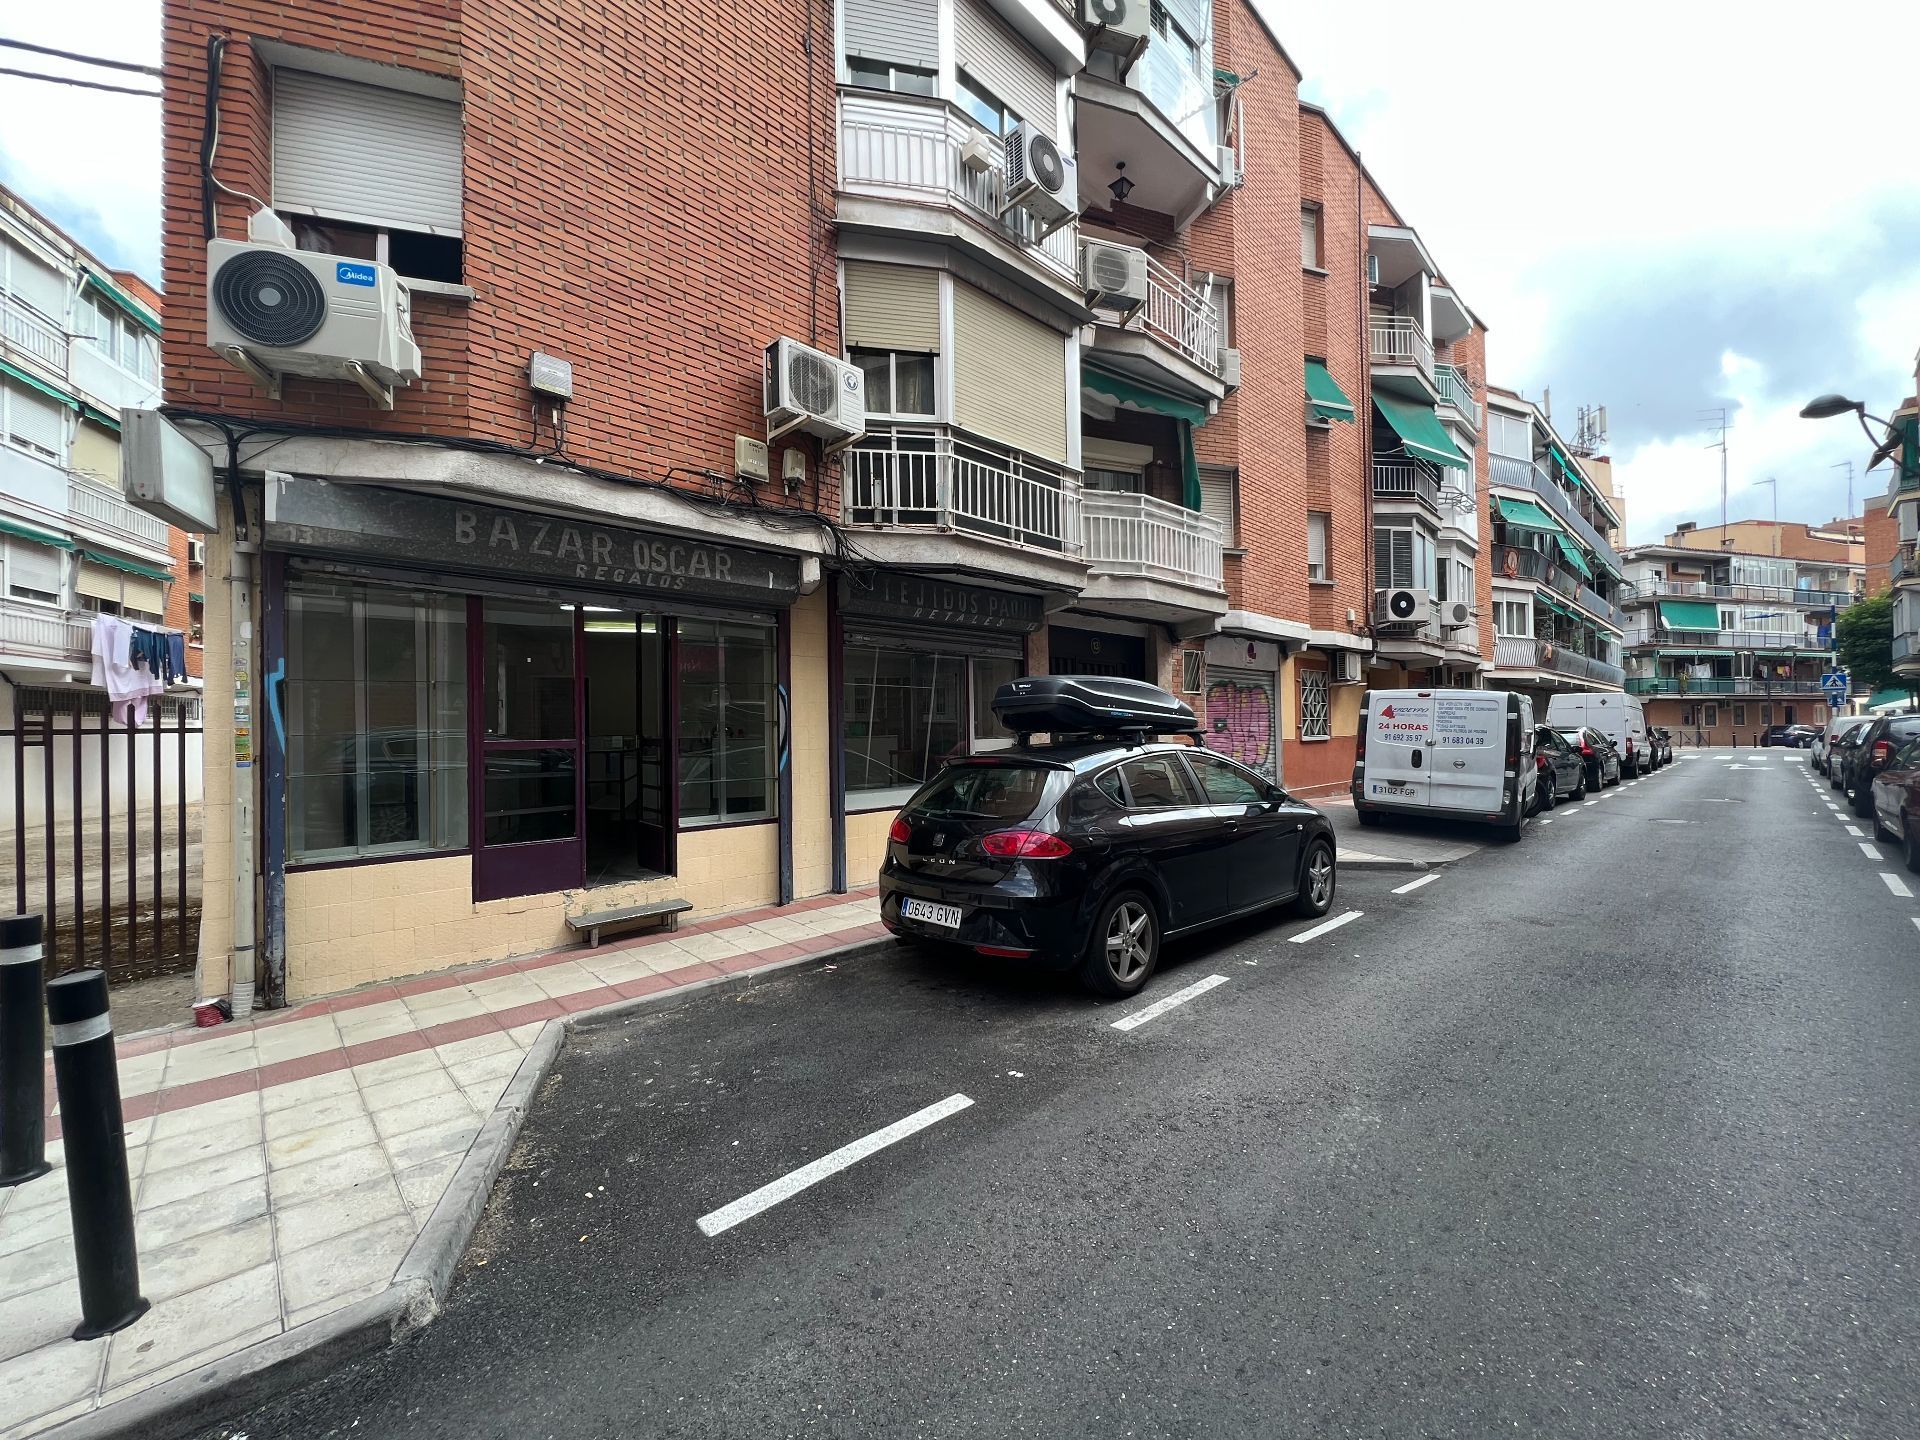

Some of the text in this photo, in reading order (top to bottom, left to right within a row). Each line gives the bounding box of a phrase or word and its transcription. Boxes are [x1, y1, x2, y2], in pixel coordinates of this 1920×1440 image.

[343, 270, 373, 281] Midea
[455, 508, 732, 582] BAZAR OSCAR
[575, 563, 686, 590] REGALOS
[883, 579, 979, 614] TEJIDOS
[913, 607, 1005, 627] RETALES
[1378, 722, 1429, 731] 24 HORAS
[1384, 733, 1423, 742] 91 692 35 97
[1442, 736, 1484, 745] 91 683 04 39
[1378, 786, 1415, 796] 3102 FGR
[922, 857, 956, 865] LEON
[908, 901, 959, 925] 0643 GVN
